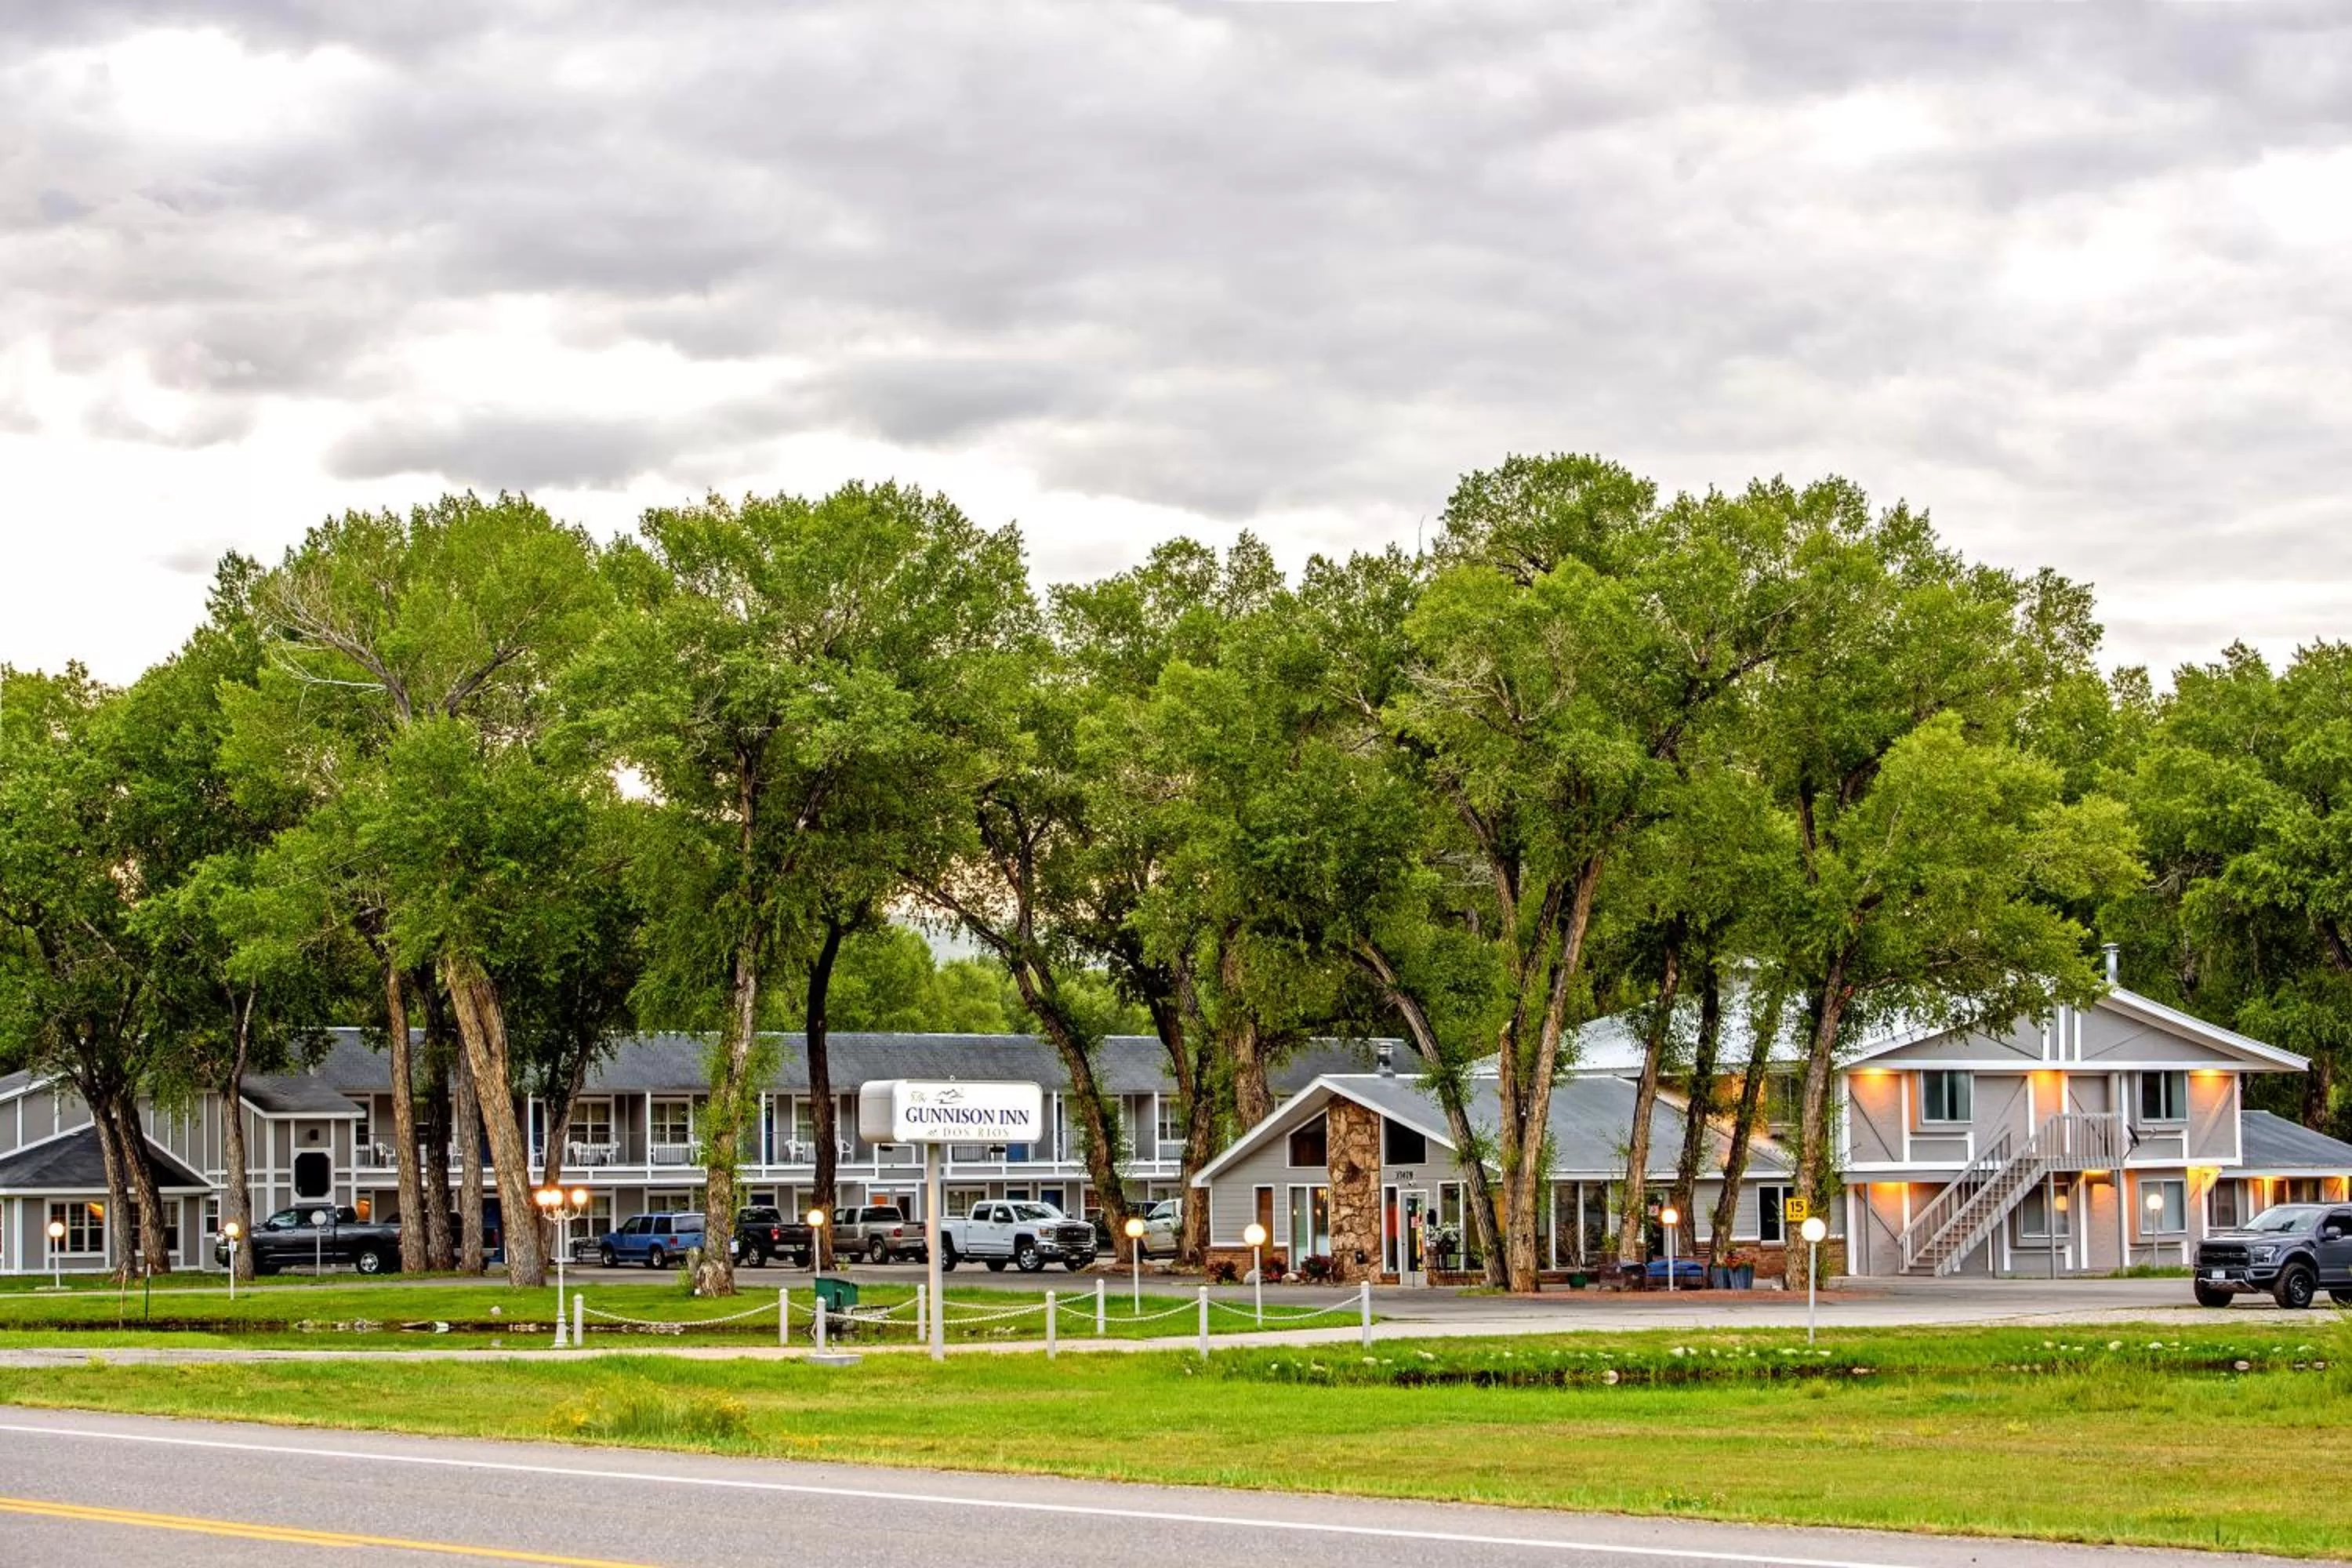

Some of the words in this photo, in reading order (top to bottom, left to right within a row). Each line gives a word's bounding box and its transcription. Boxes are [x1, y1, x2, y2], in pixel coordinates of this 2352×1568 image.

[906, 1106, 995, 1125] GUNNISON
[1000, 1109, 1029, 1125] INN
[943, 1127, 970, 1138] DOS
[978, 1127, 1010, 1138] RIOS
[1790, 1200, 1804, 1213] 15
